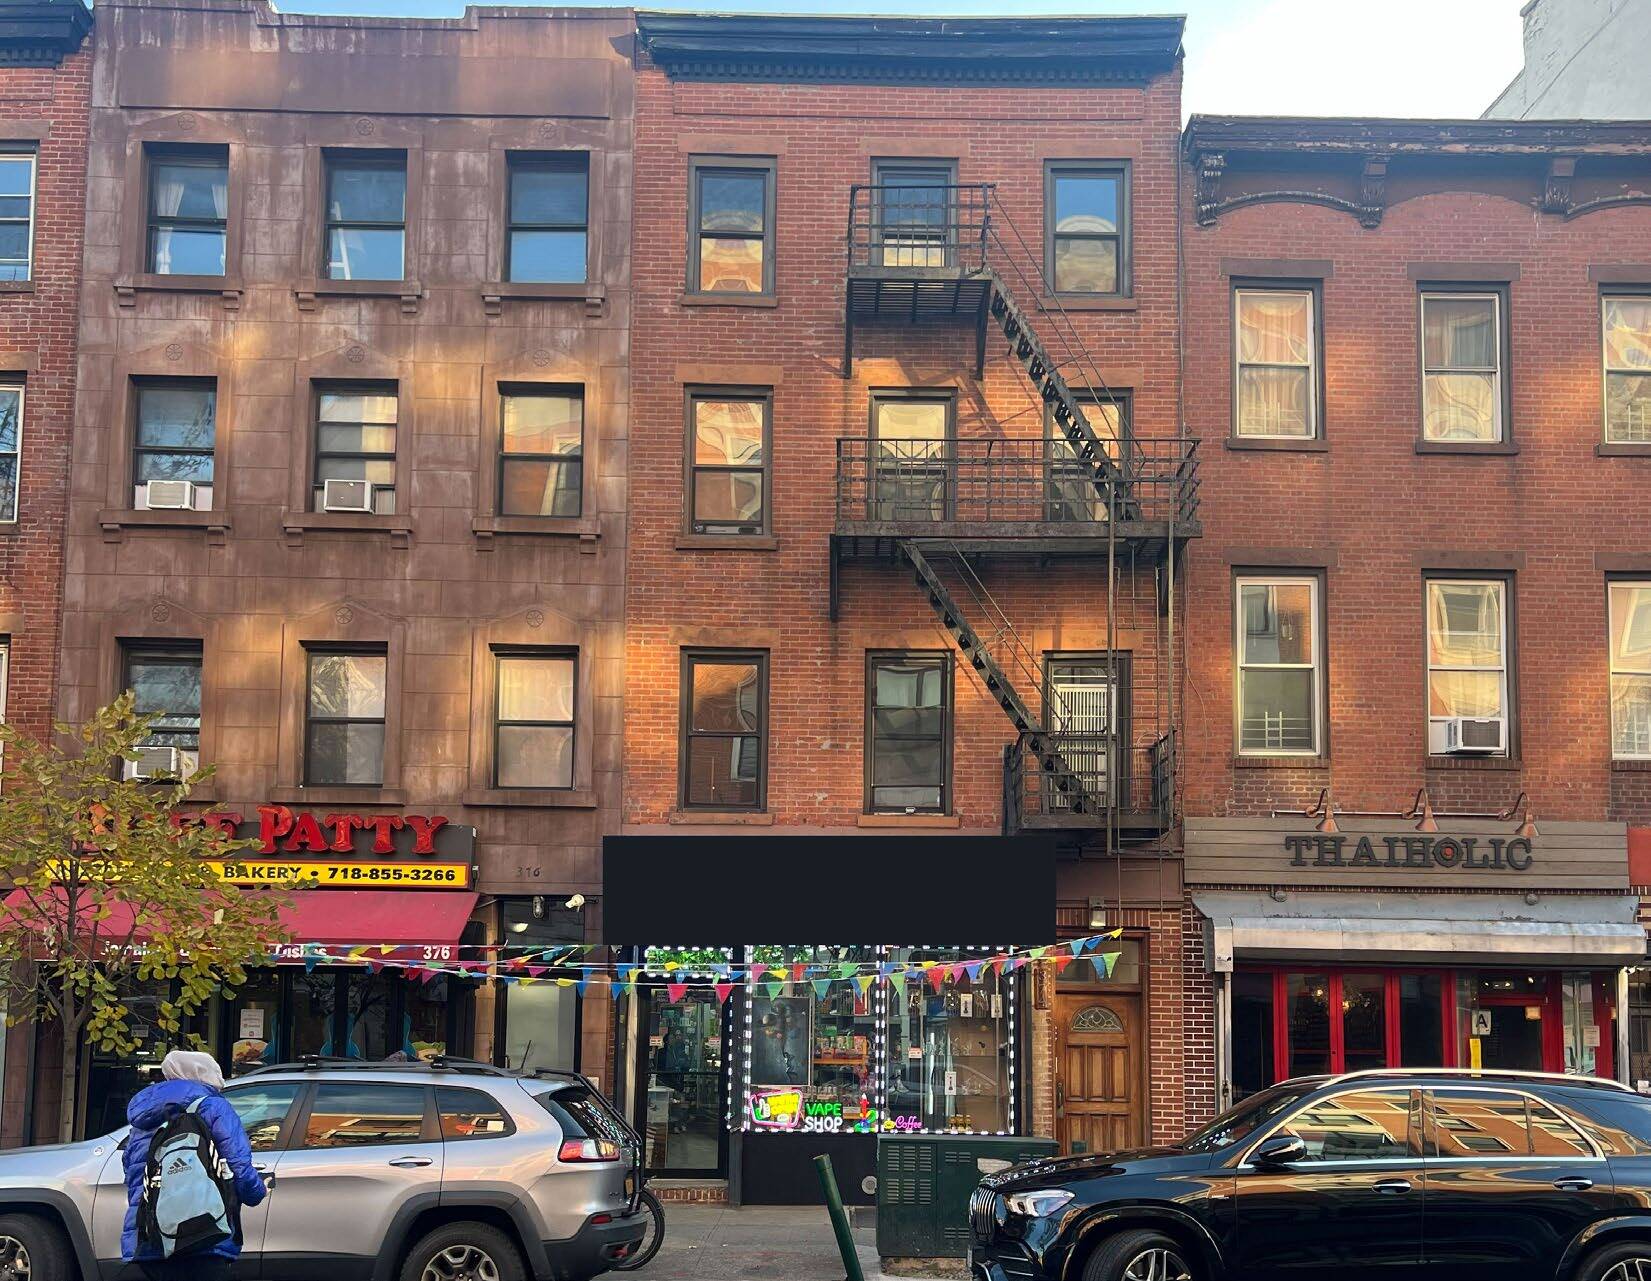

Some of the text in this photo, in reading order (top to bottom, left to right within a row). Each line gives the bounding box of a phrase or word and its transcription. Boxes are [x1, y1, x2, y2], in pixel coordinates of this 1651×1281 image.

[256, 804, 449, 854] PATTY
[1285, 836, 1533, 870] THAIHOLIC
[224, 866, 302, 879] BAKERY
[328, 867, 456, 881] 718-855-3266
[423, 945, 450, 959] 376
[1476, 1014, 1488, 1028] A
[805, 1103, 842, 1116] VAPE
[804, 1116, 843, 1131] SHOP
[895, 1115, 922, 1130] Coffee
